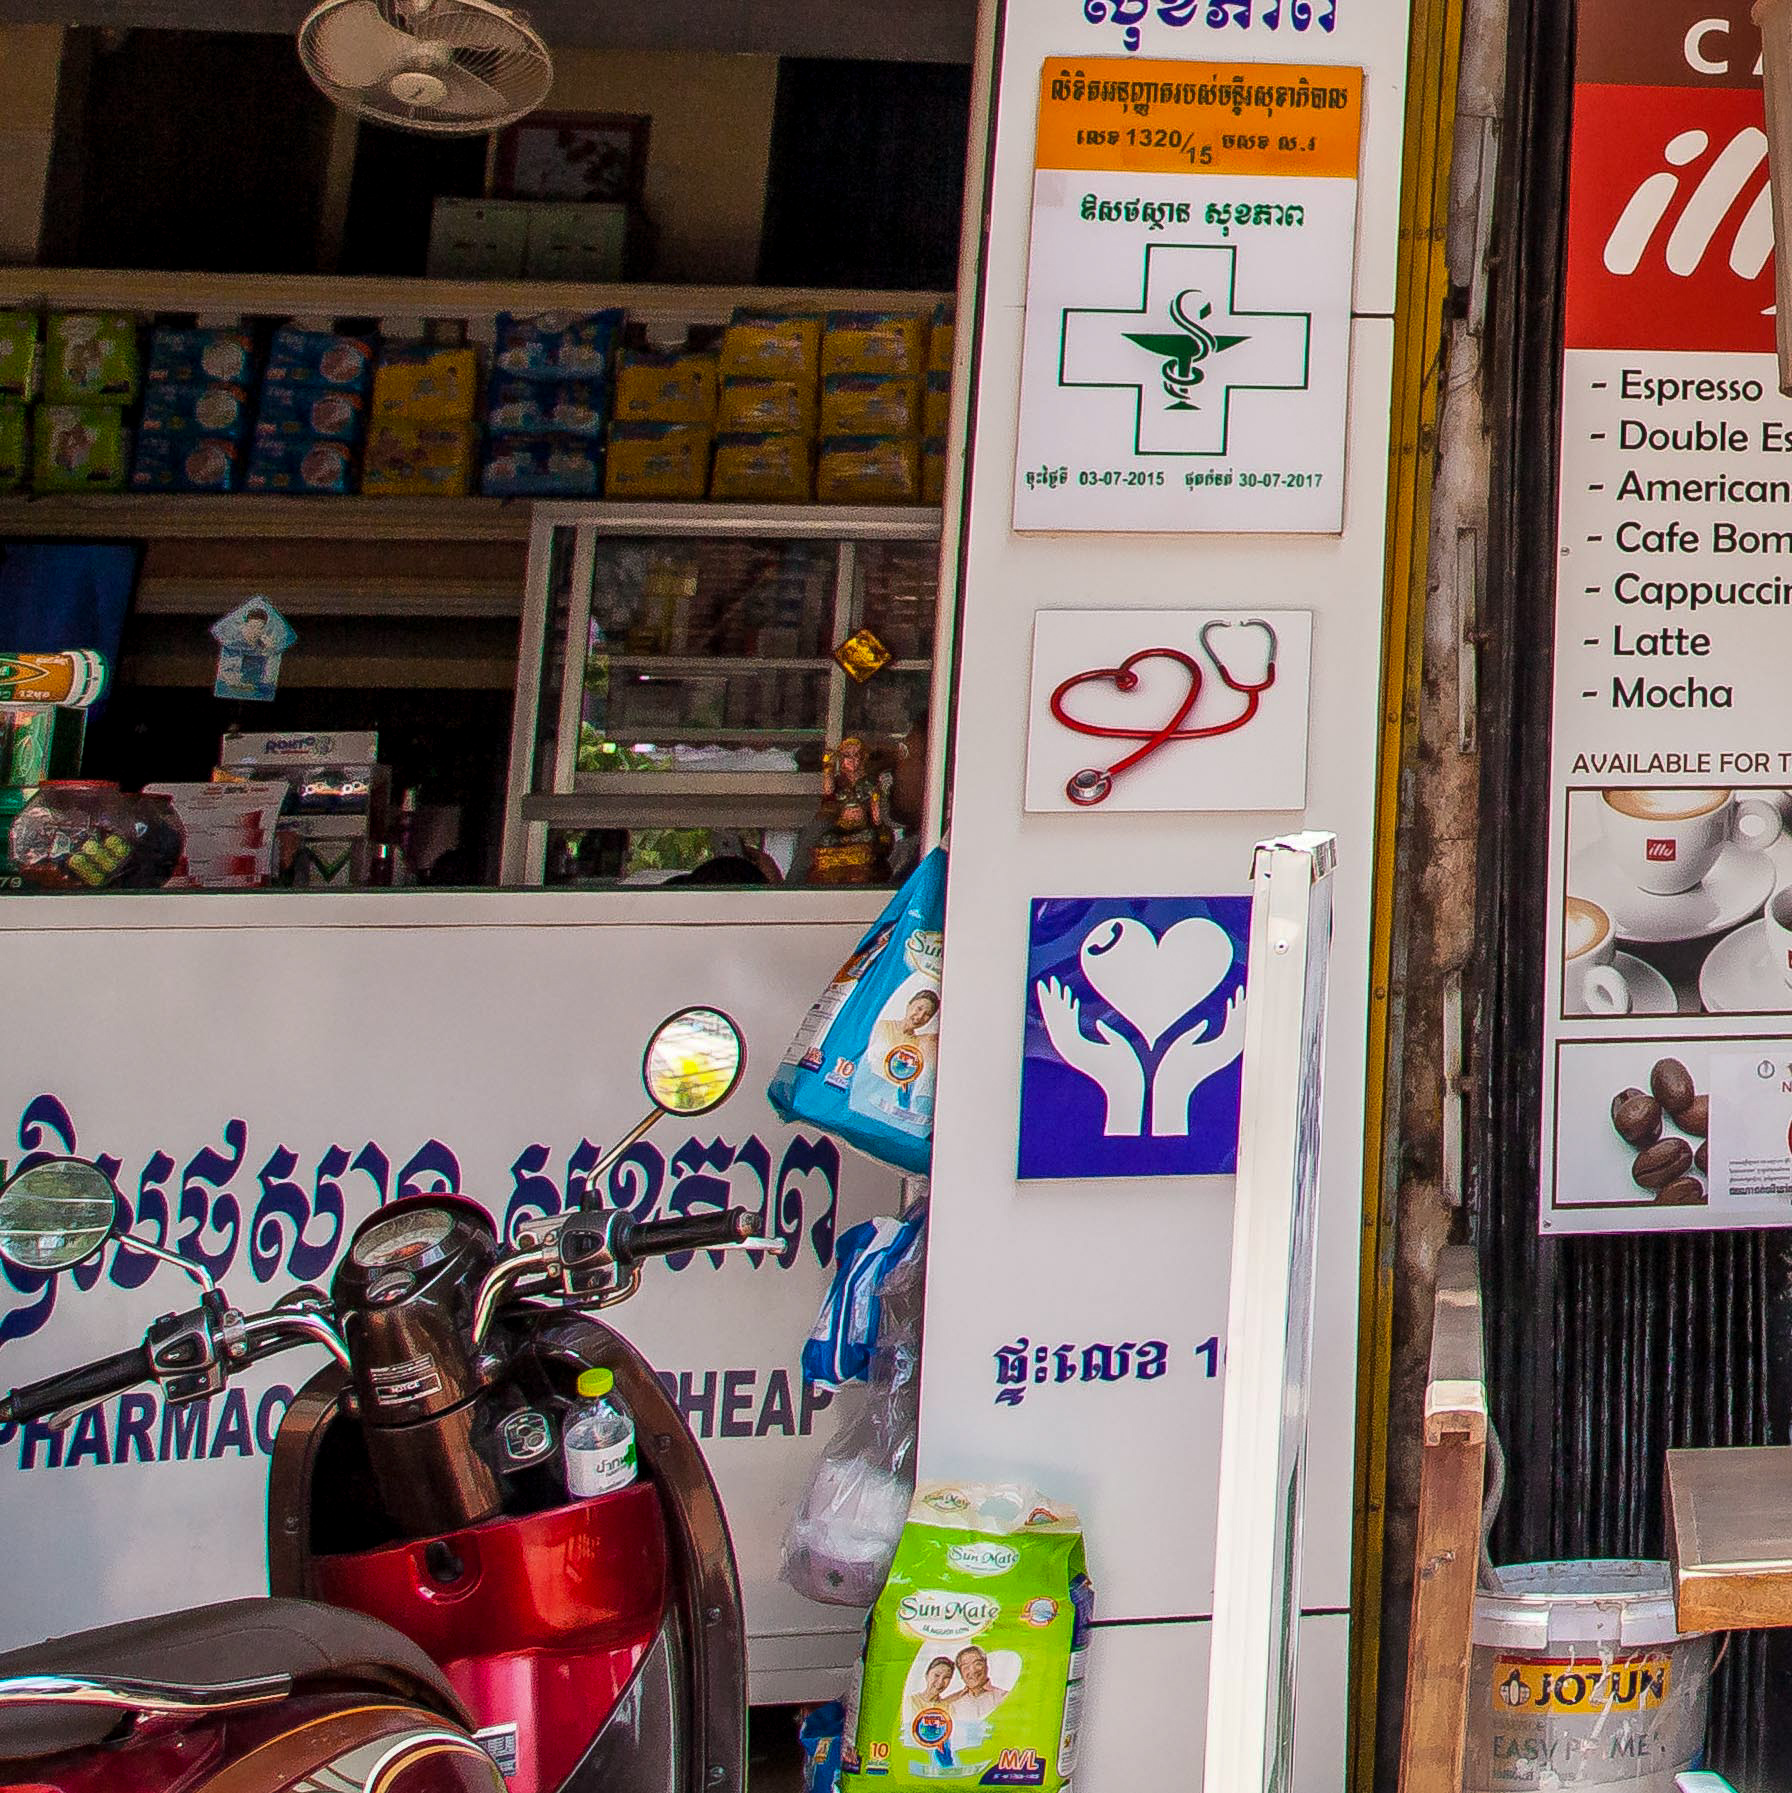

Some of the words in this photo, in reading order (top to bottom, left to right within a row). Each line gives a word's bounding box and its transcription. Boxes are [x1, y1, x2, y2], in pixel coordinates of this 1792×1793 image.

[1620, 369, 1764, 406] Espresso
[1619, 420, 1749, 452] Double
[1078, 470, 1165, 487] 03-07-2015
[1238, 472, 1323, 489] 30-07-2017
[1616, 522, 1699, 554] Cafe
[1613, 625, 1711, 656] Latte
[1612, 677, 1733, 708] Mocha
[1572, 753, 1711, 775] AVAILABLE
[1720, 752, 1769, 774] FOR
[655, 1369, 834, 1437] HEAP
[0, 1385, 293, 1470] HARMAC
[949, 1546, 979, 1563] Sun
[981, 1551, 1020, 1569] Mate
[898, 1597, 942, 1620] Sun
[944, 1602, 1000, 1626] Mate
[1535, 1668, 1664, 1706] JOTUN
[871, 1741, 890, 1758] 10
